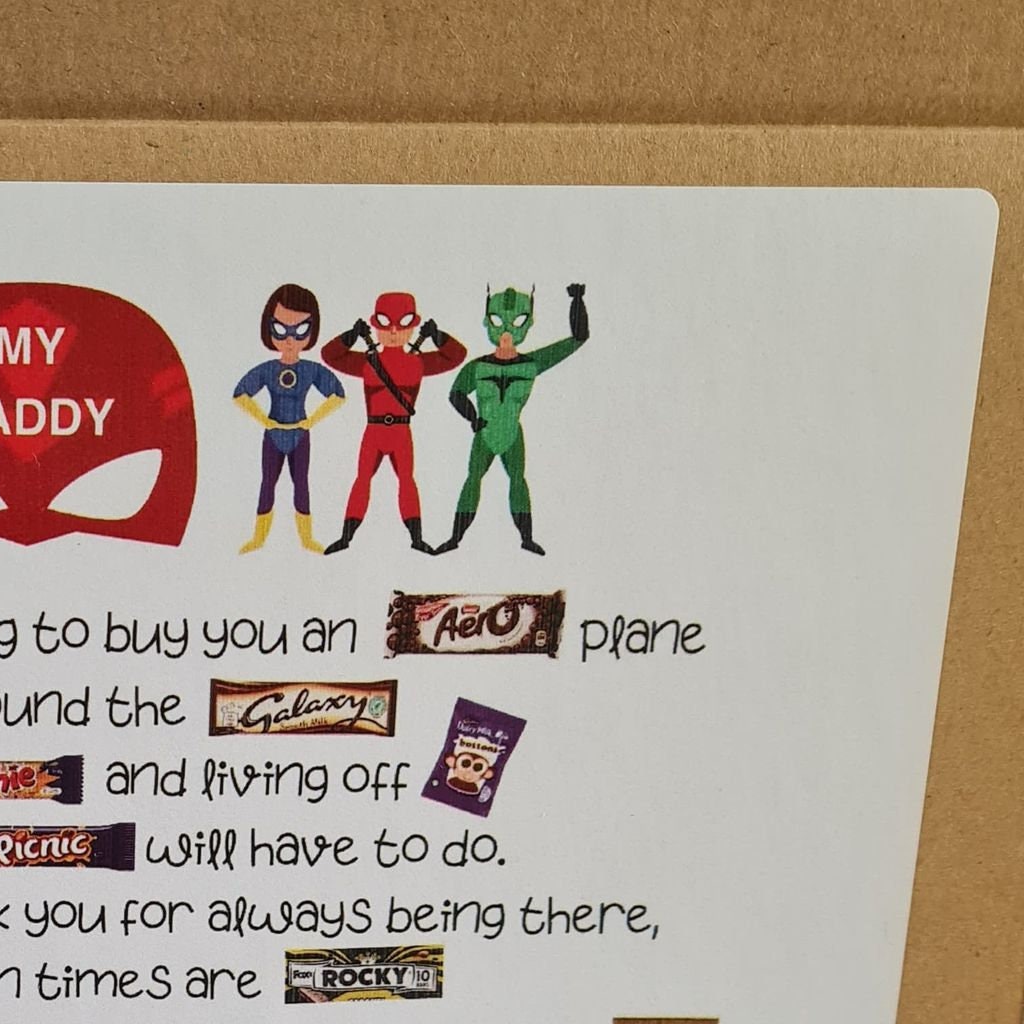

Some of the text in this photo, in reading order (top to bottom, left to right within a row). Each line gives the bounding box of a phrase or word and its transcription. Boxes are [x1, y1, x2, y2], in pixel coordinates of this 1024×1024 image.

[32, 611, 89, 654] to
[104, 611, 188, 659] buy
[203, 618, 287, 659] you
[302, 617, 357, 653] an
[580, 615, 706, 662] plane
[105, 686, 186, 727] the
[238, 688, 368, 733] Galaxy
[106, 758, 187, 797] and
[201, 758, 328, 804] living
[343, 762, 410, 801] off
[146, 829, 236, 871] will
[251, 828, 358, 867] have
[374, 828, 429, 868] to
[442, 829, 505, 867] do.
[24, 900, 106, 938] you
[120, 900, 194, 936] for
[208, 896, 372, 938] always
[386, 896, 505, 940] being
[520, 896, 659, 940] there,
[35, 962, 171, 1000] times
[186, 967, 261, 1000] are
[322, 967, 408, 987] ROCKY
[416, 970, 430, 981] 10
